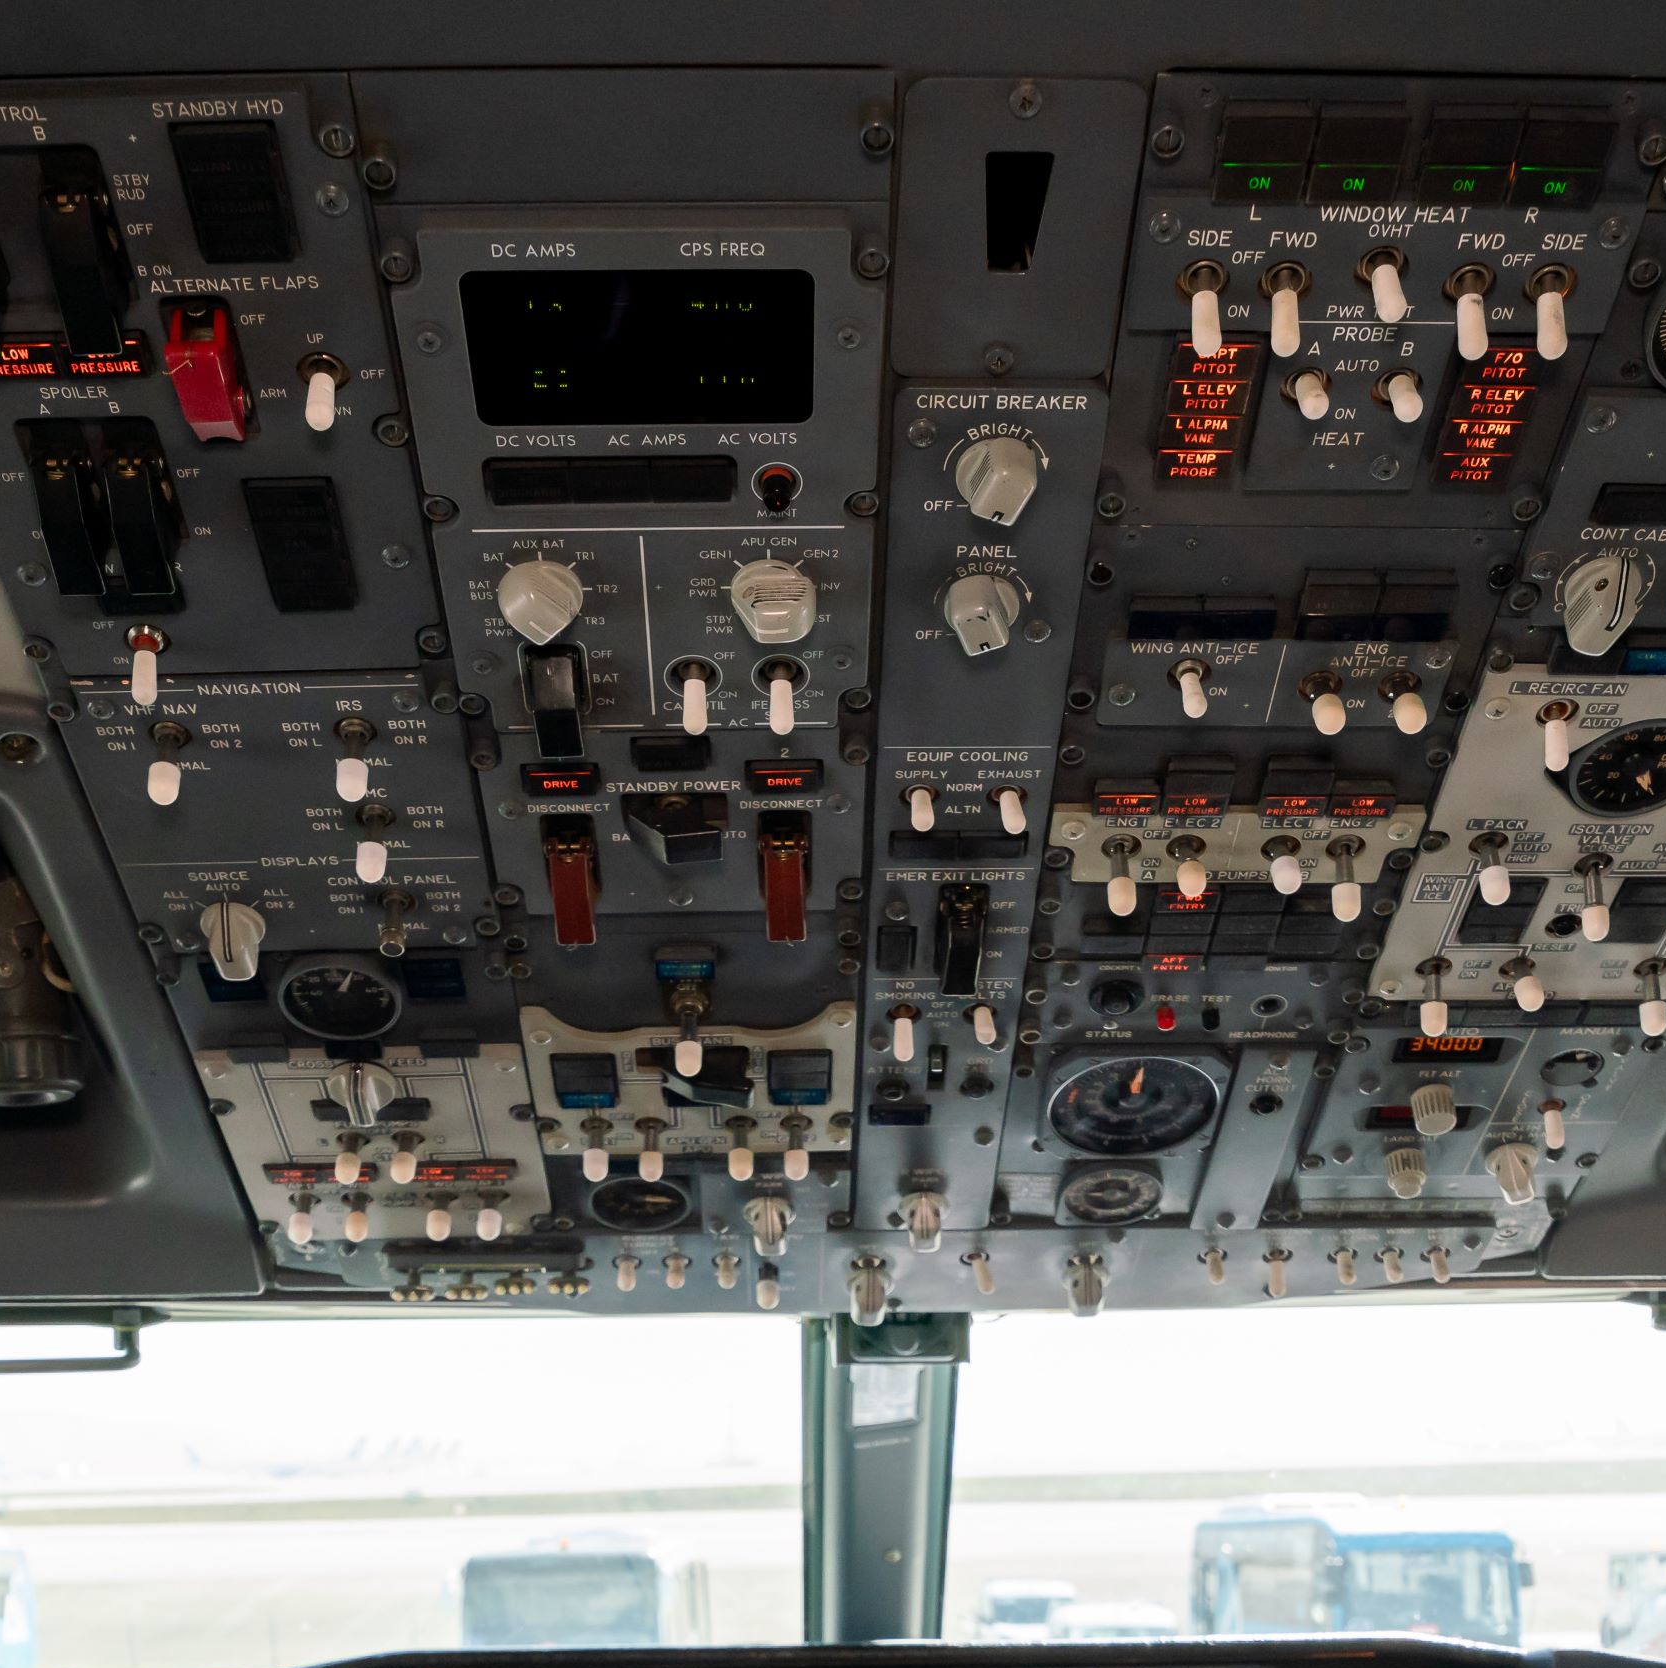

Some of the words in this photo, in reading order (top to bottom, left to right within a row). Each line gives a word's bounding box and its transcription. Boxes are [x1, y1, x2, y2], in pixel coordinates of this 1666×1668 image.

[152, 101, 238, 118] STANDBY
[245, 100, 284, 117] HYD
[1248, 177, 1271, 191] ON
[1319, 206, 1407, 224] WINDOW
[1414, 207, 1471, 224] HEAT
[1367, 224, 1414, 239] OVHT
[1187, 230, 1232, 248] SIDE
[1269, 231, 1318, 249] FWD
[490, 242, 517, 258] DC
[525, 242, 576, 258] AMPS
[679, 242, 713, 258] CPS
[719, 242, 766, 258] FREQ
[149, 277, 254, 293] ALTERNATE
[260, 275, 319, 291] FLAPS
[306, 332, 324, 344] UP
[1332, 327, 1397, 343] PROBE
[1495, 352, 1523, 365] F/O
[1192, 362, 1237, 375] PITOT
[1334, 360, 1380, 373] AUTO
[39, 384, 110, 400] SPOILER
[259, 387, 287, 399] ARM
[1183, 384, 1193, 397] L
[1196, 384, 1236, 397] ELEV
[1470, 389, 1483, 401] R
[1485, 389, 1524, 402] ELEV
[916, 395, 989, 410] CIRCUIT
[996, 395, 1088, 410] BREAKER
[1175, 419, 1185, 431] L
[1188, 419, 1229, 431] ALPHA
[966, 423, 1034, 441] BRIGHT
[495, 434, 521, 448] DC
[525, 434, 576, 448] VOLTS
[607, 433, 631, 447] AC
[641, 432, 687, 447] AMPS
[717, 432, 741, 447] AC
[748, 432, 798, 446] VOLTS
[1184, 433, 1215, 445] VANE
[1312, 431, 1364, 447] HEAT
[1177, 453, 1216, 465] TEMP
[1460, 457, 1491, 469] AUX
[1169, 466, 1218, 478] PROBE
[923, 500, 954, 512] OFF
[1580, 528, 1628, 541] CONT
[512, 539, 539, 550] AUX
[542, 539, 565, 550] BAT
[740, 536, 766, 548] APU
[769, 536, 797, 547] GEN
[575, 551, 596, 562] TR1
[956, 545, 1018, 558] PANEL
[689, 576, 717, 588] GRD
[819, 581, 841, 592] INV
[596, 583, 619, 595] TR2
[1130, 642, 1174, 654] WING
[1354, 643, 1389, 655] ENG
[197, 682, 302, 696] NAVIGATION
[1512, 684, 1523, 695] L
[1526, 683, 1587, 695] RECIRC
[1592, 684, 1628, 695] FAN
[163, 703, 197, 715] NAV
[336, 699, 363, 712] IRS
[95, 726, 136, 737] BOTH
[906, 751, 954, 763] EQUIP
[959, 751, 1029, 762] COOLING
[895, 770, 948, 780] SUPPLY
[977, 770, 1042, 779] EXHAUST
[543, 779, 579, 789] DRIVE
[605, 781, 679, 793] STANDBY
[683, 780, 741, 792] POWER
[946, 783, 983, 792] NORM
[739, 799, 823, 810] DISCONNECT
[1115, 797, 1139, 806] LOW
[526, 803, 611, 813] DISCONNECT
[944, 805, 981, 814] ALTN
[1098, 806, 1152, 815] PRESSURE
[1468, 819, 1478, 830] L
[1482, 820, 1527, 830] PACK
[1571, 824, 1653, 835] ISOLATION
[1581, 834, 1632, 845] VALVE
[260, 856, 339, 867] DISPLAYS
[188, 871, 250, 882] SOURCE
[885, 871, 927, 882] EMER
[932, 871, 966, 881] EXIT
[971, 871, 1026, 881] LIGHTS
[1217, 871, 1268, 881] PUMPS
[895, 981, 915, 990] NO
[874, 991, 936, 1000] SMOKING
[1559, 1027, 1623, 1036] MANUAL
[1409, 1036, 1483, 1052] 34000
